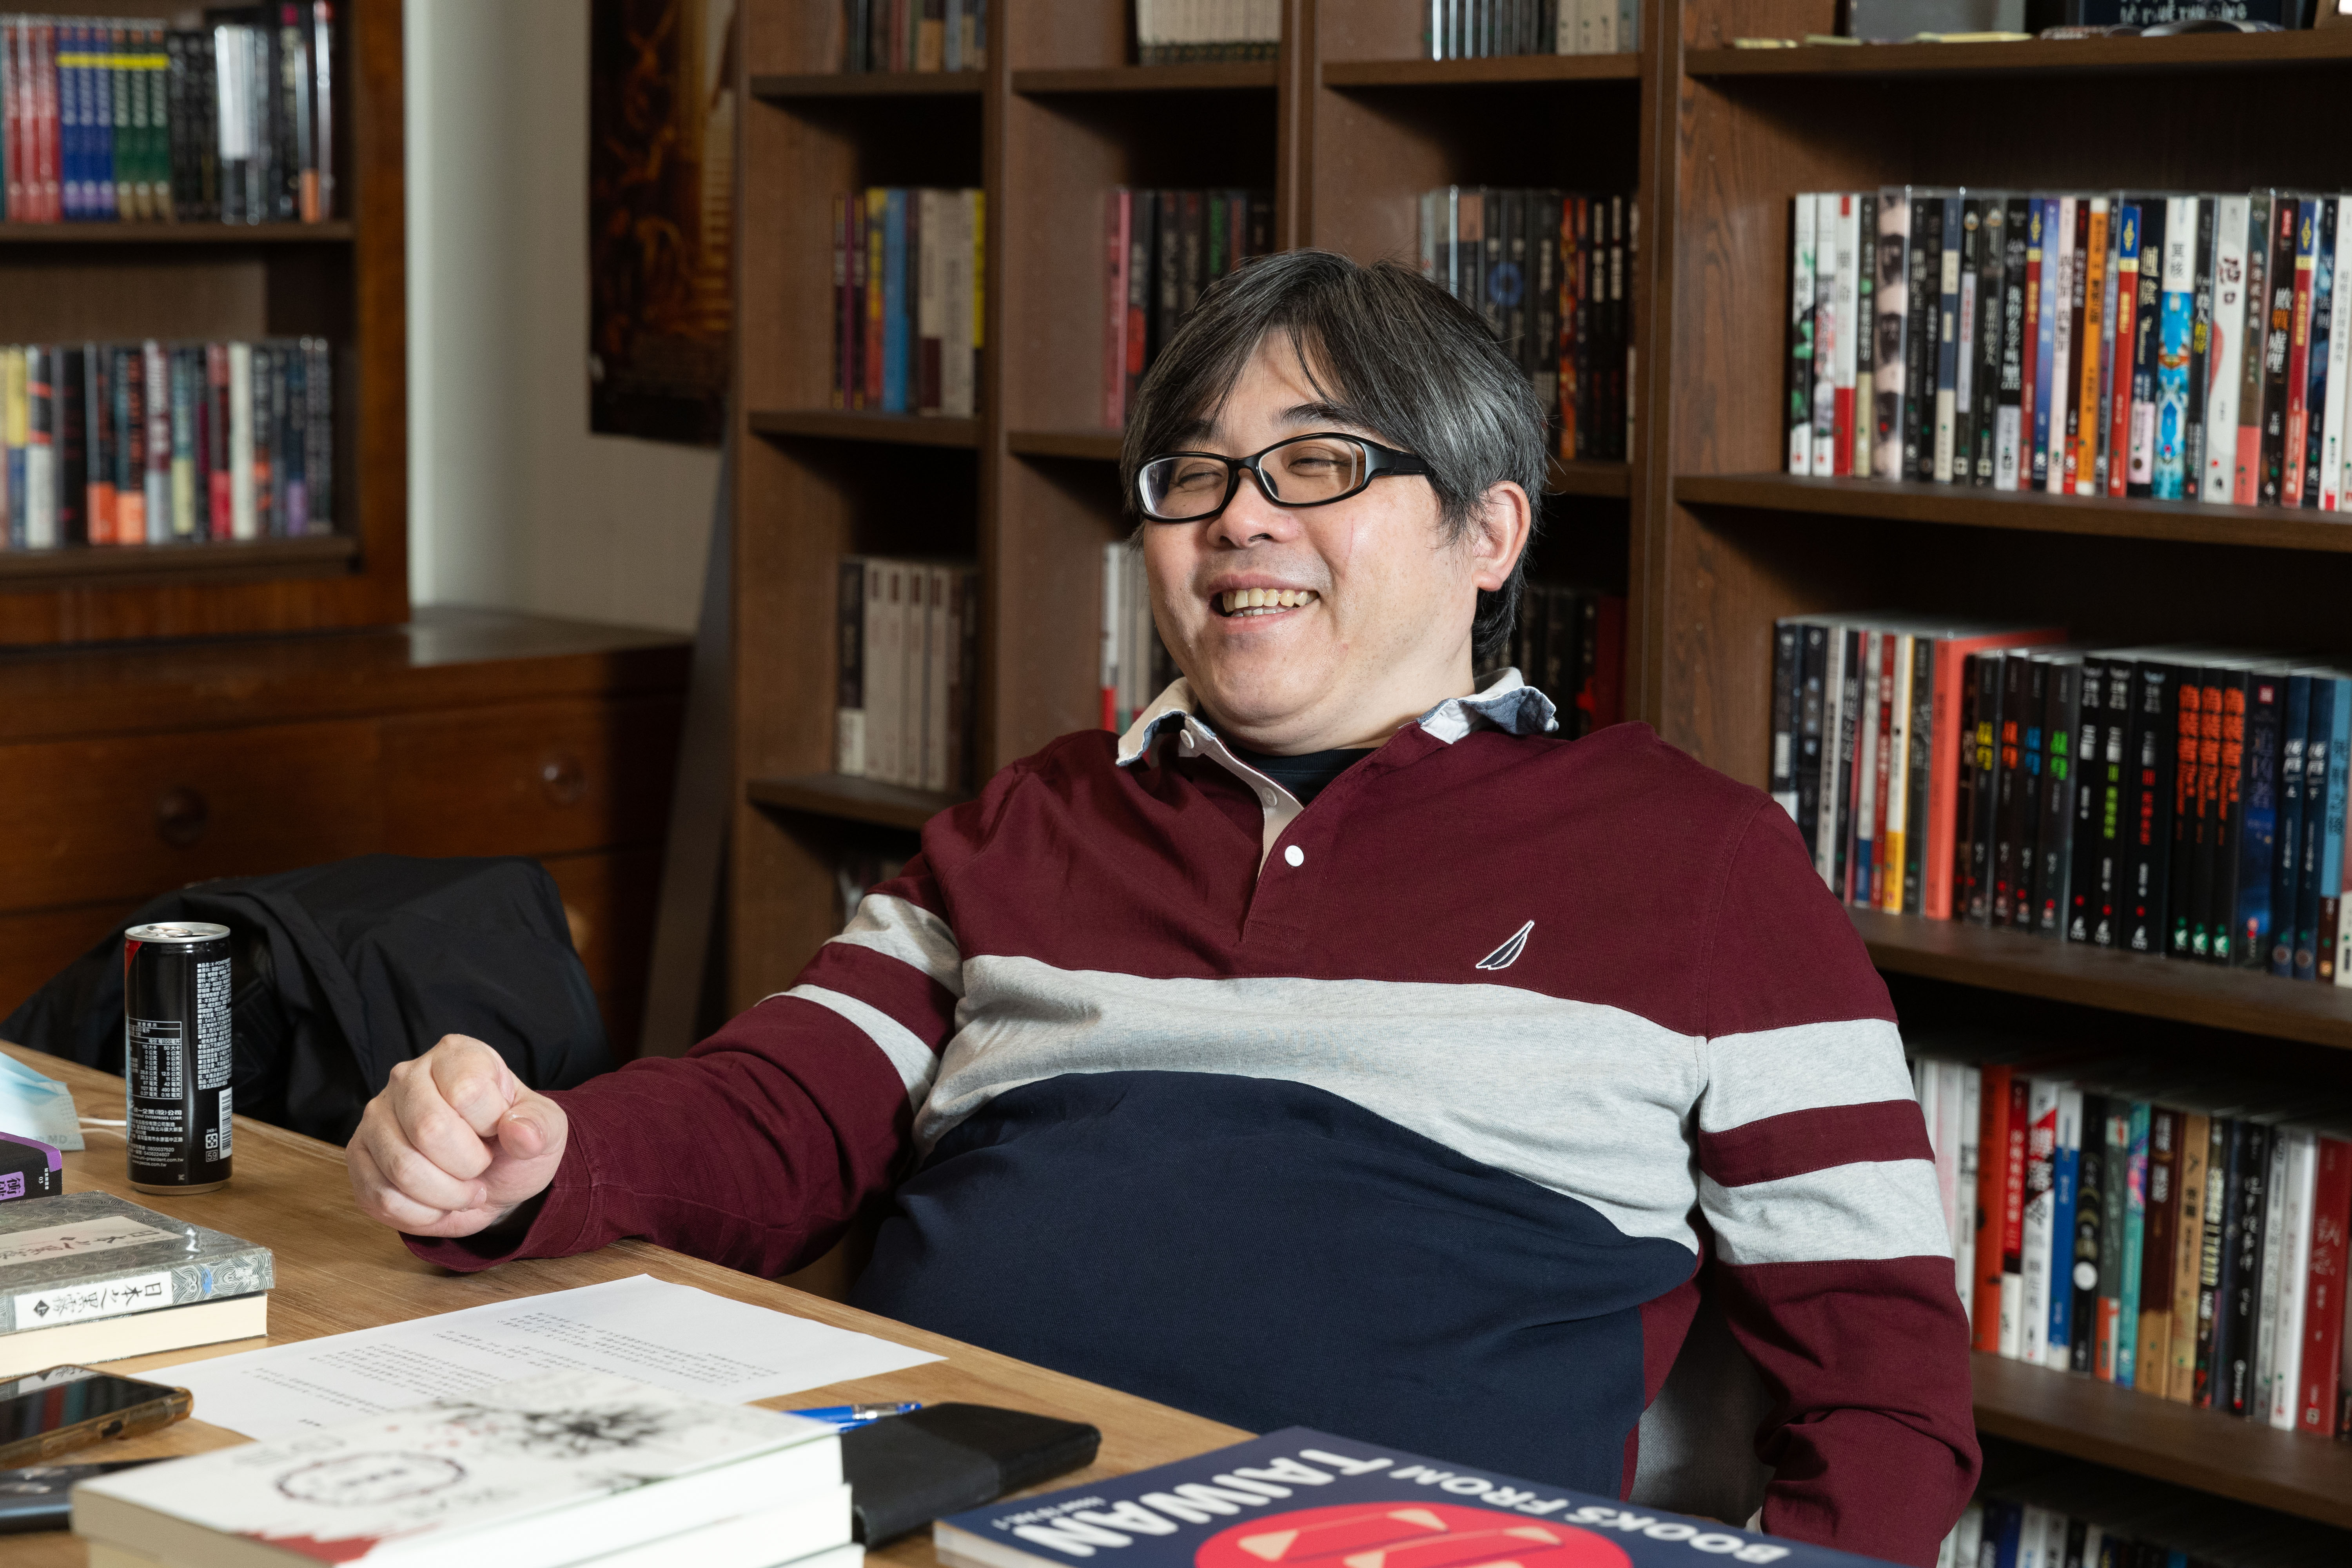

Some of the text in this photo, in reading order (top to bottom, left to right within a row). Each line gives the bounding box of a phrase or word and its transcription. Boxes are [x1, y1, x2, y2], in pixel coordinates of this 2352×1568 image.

[207, 1152, 217, 1160] 59
[1013, 1448, 1394, 1557] TAIWAN
[1388, 1465, 1791, 1564] BOOKS FROM
